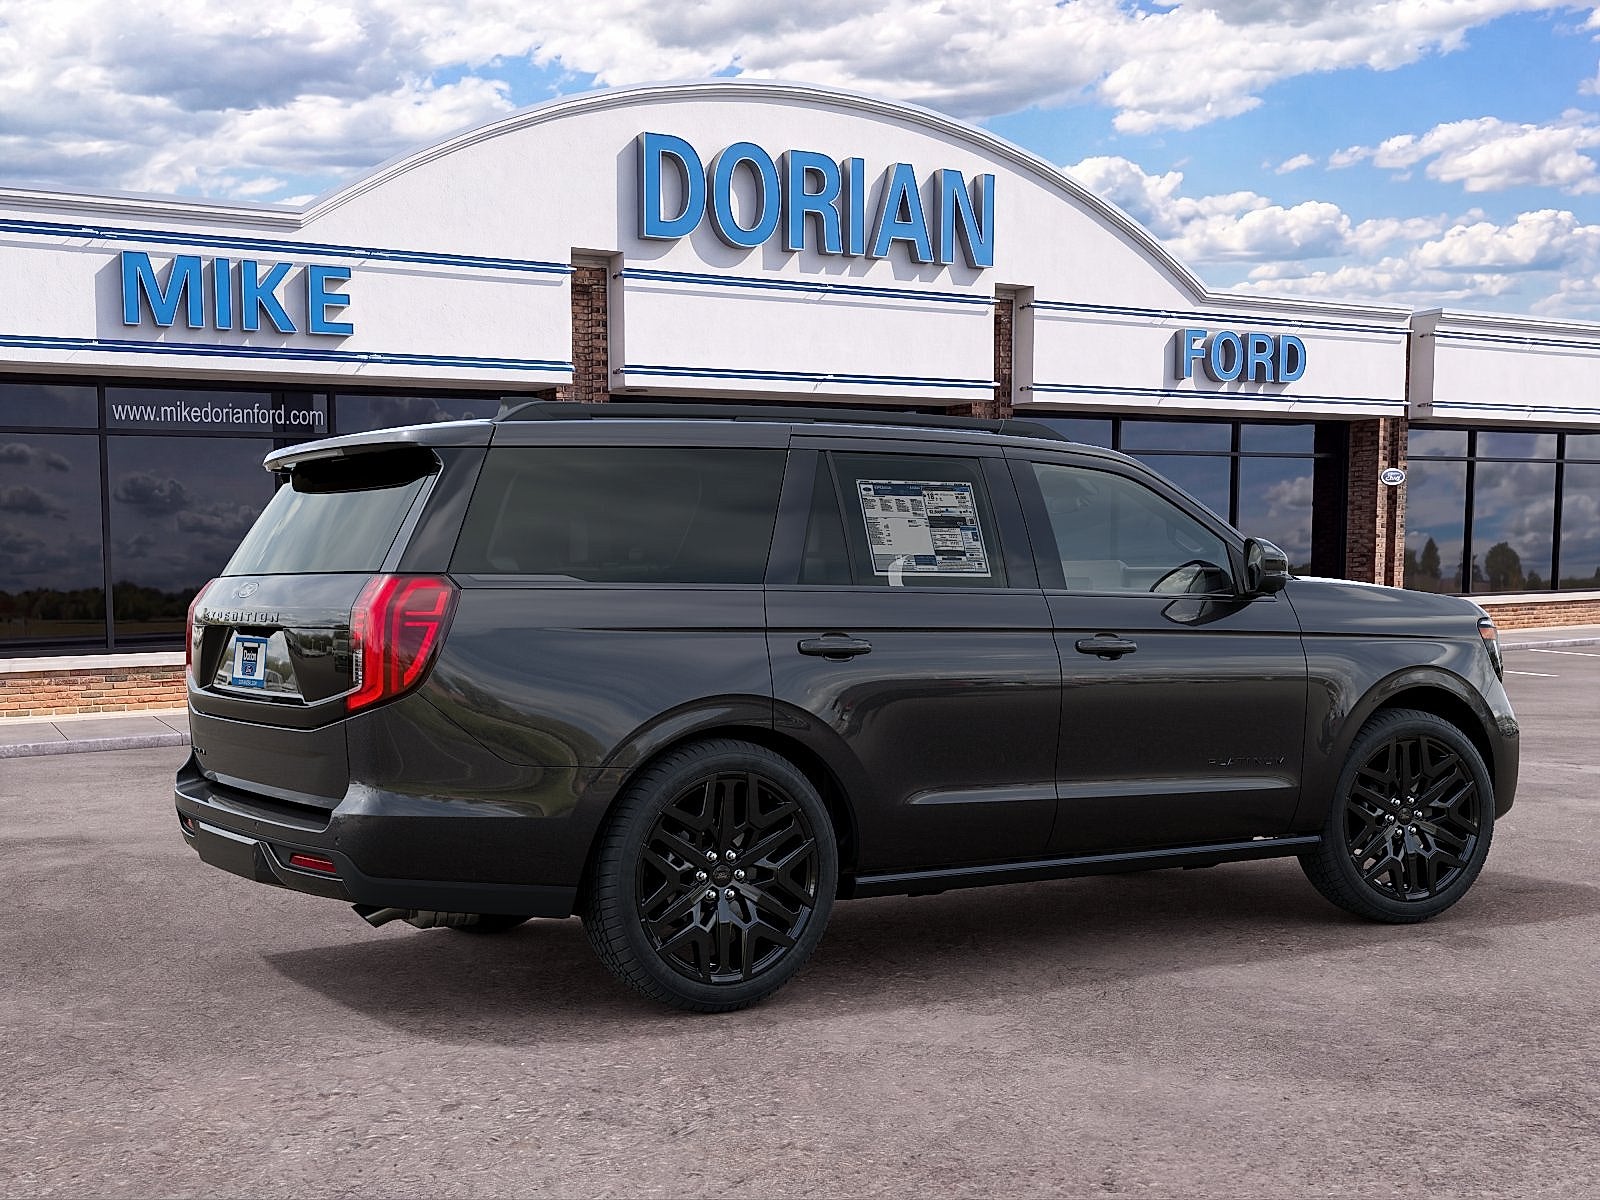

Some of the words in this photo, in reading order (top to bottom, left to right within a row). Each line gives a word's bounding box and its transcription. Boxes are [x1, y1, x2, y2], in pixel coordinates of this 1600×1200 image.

[638, 131, 996, 269] DORIAN
[121, 250, 355, 336] MIKE
[1178, 328, 1307, 384] FORD
[111, 401, 325, 426] www.mikedorianford.com
[243, 649, 257, 661] Dorian
